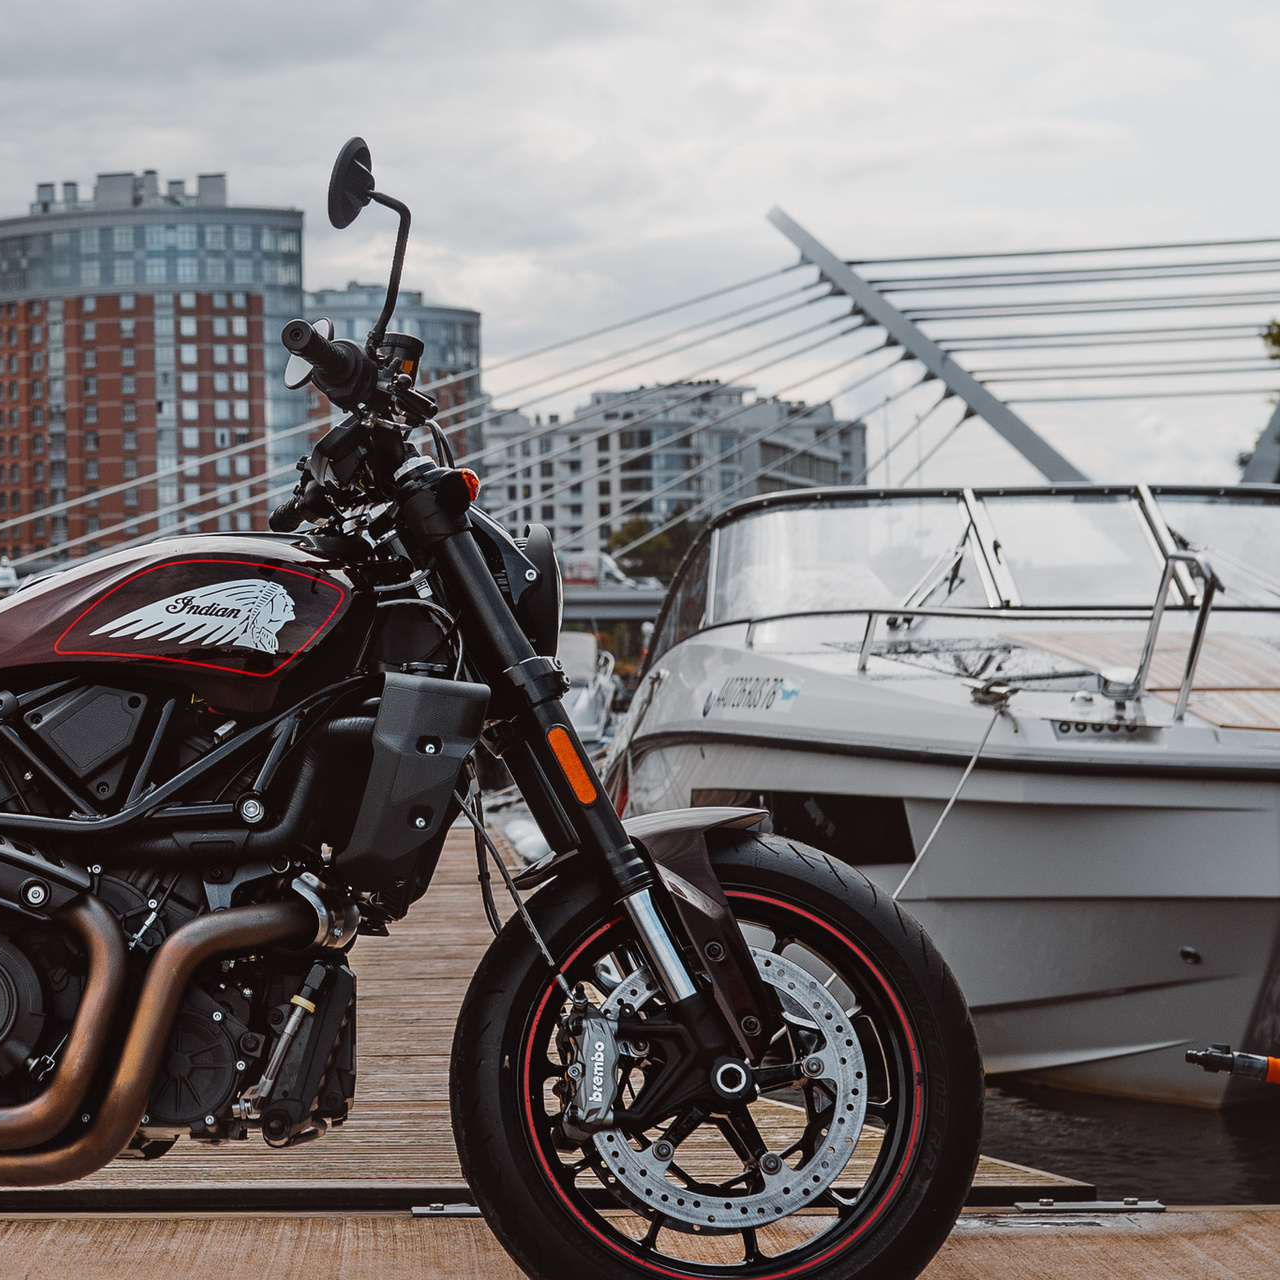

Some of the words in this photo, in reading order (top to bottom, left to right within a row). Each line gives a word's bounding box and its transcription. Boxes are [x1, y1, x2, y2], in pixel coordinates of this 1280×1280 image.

[165, 596, 241, 618] Indian
[588, 1041, 605, 1102] brembo
[919, 1124, 944, 1171] RR
